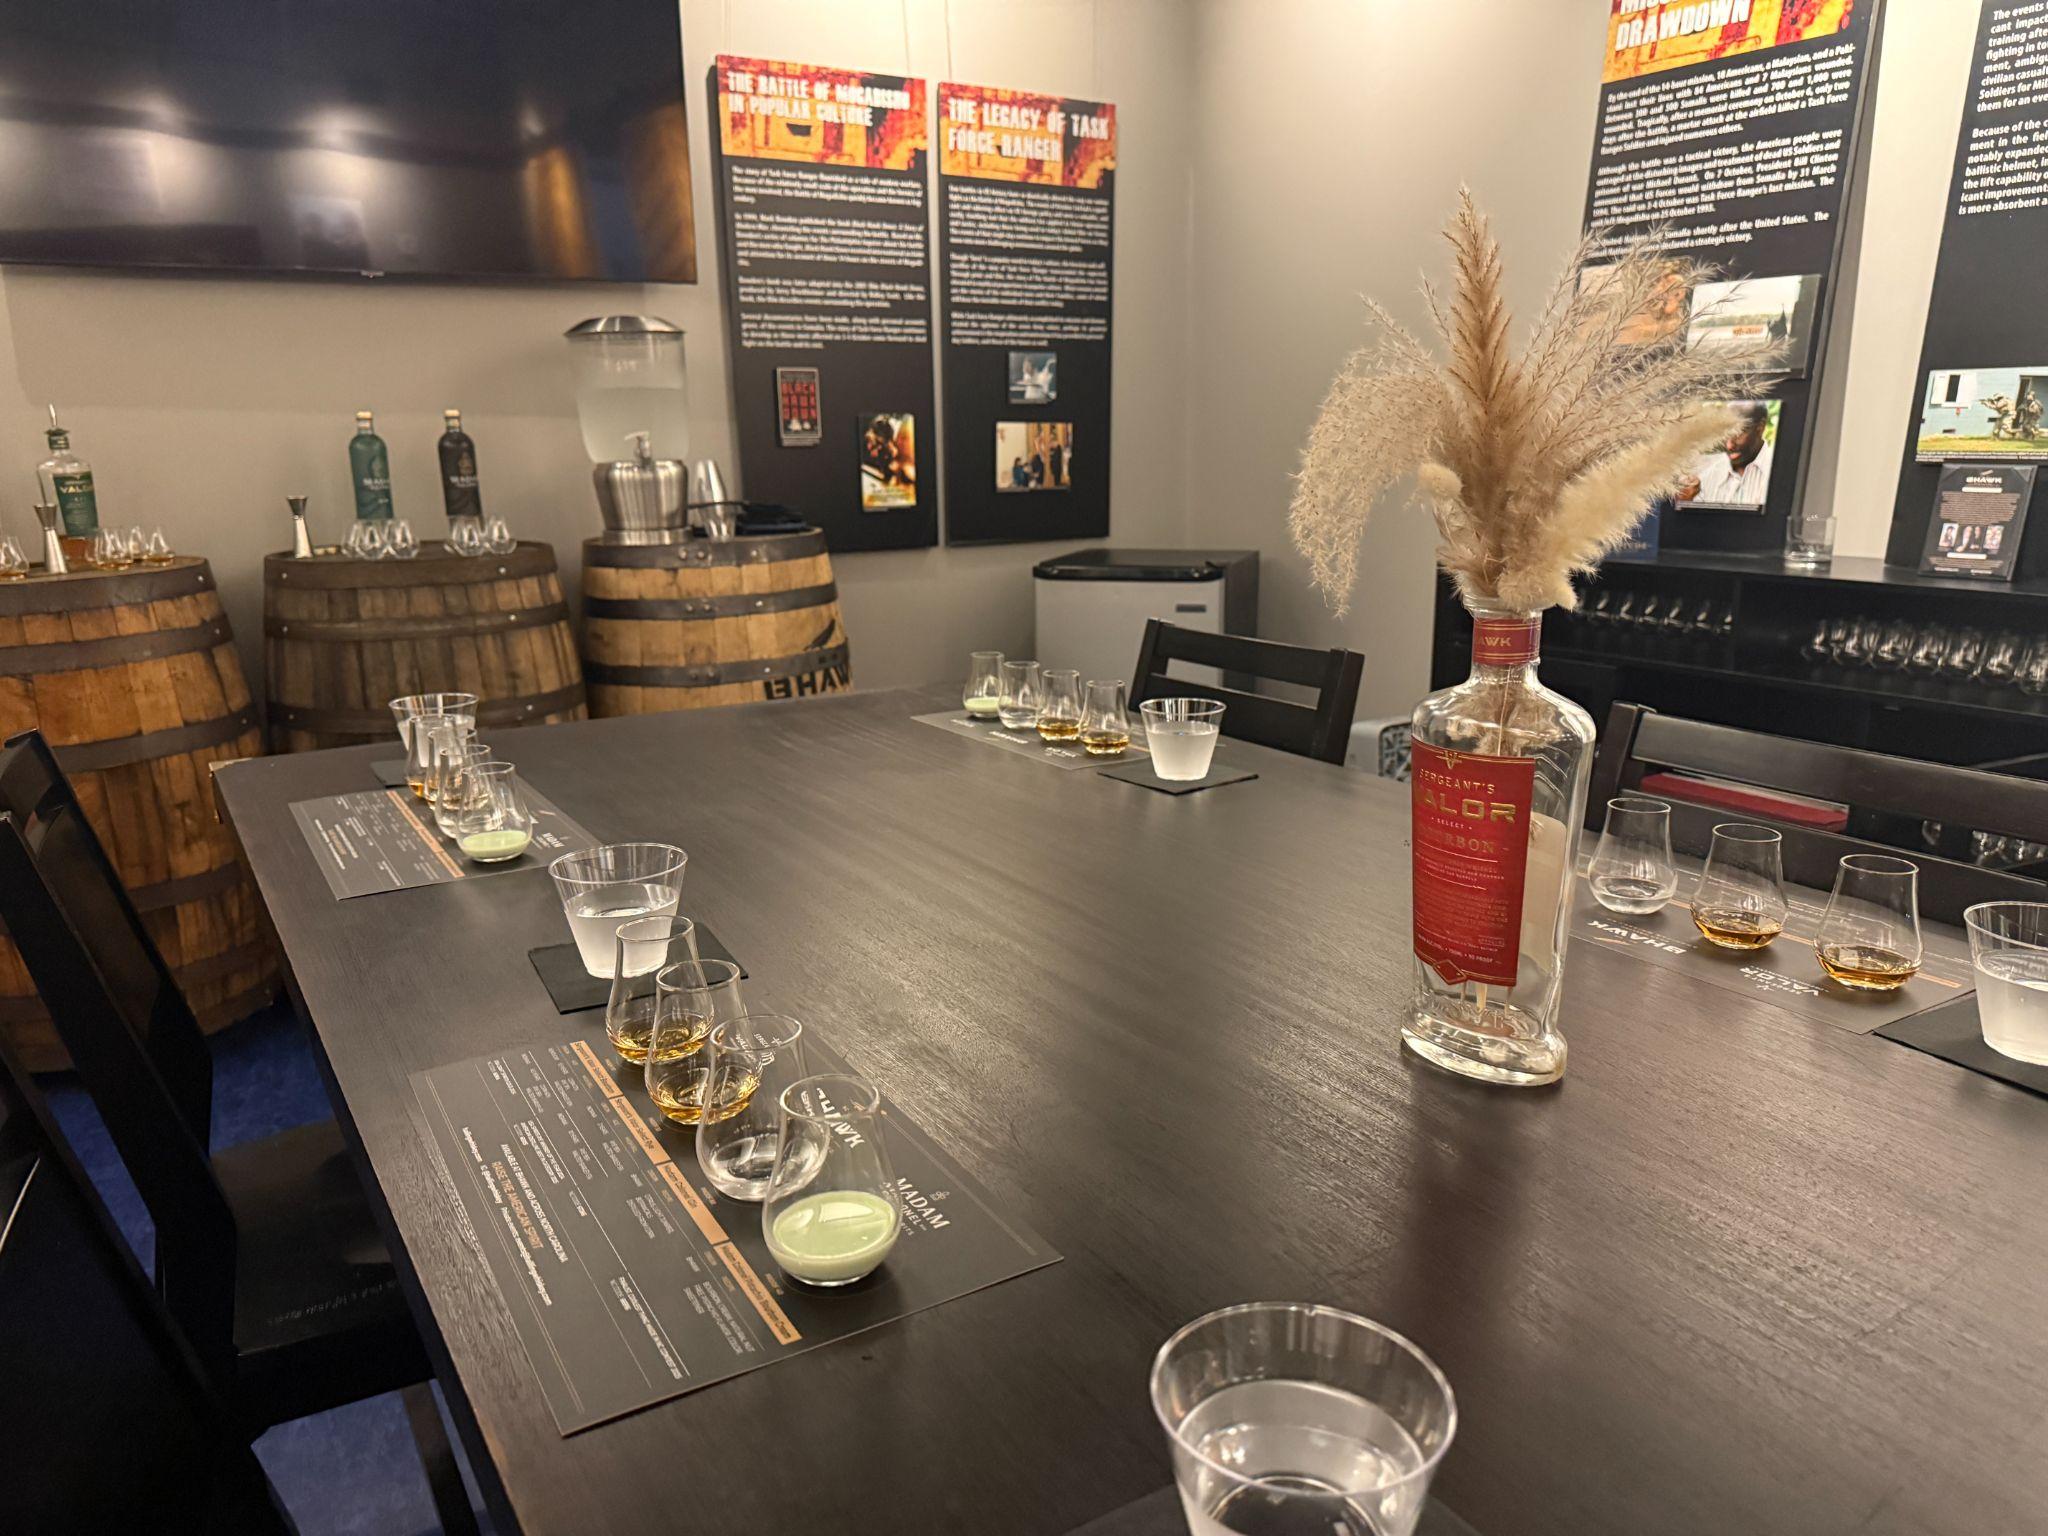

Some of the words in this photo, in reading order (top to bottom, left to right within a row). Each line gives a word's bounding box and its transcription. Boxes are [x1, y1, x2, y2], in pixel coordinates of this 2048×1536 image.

[1994, 10, 2010, 20] The
[2012, 3, 2044, 16] events
[1615, 0, 1751, 51] DRAWDOWN
[1990, 22, 2012, 34] cant
[1988, 33, 2026, 47] training
[1812, 49, 1828, 60] and
[1986, 46, 2024, 61] fighting
[2025, 42, 2036, 52] in
[1745, 75, 1760, 84] and
[1815, 57, 1854, 70] wounded.
[1984, 60, 2011, 73] ment,
[727, 71, 754, 93] THE
[758, 75, 809, 98] BATTLE
[814, 82, 830, 100] OF
[1730, 88, 1751, 99] killed
[1753, 84, 1768, 94] and
[1788, 77, 1804, 87] and
[1831, 70, 1852, 79] were
[1981, 73, 2014, 86] civilian
[1979, 86, 2016, 100] Soldiers
[2017, 82, 2032, 92] for
[728, 93, 746, 114] IN
[751, 97, 811, 120] POPULAR
[1778, 101, 1799, 112] killed
[1808, 96, 1825, 107] Task
[1826, 93, 1848, 102] Force
[1977, 101, 2002, 112] them
[2003, 97, 2018, 108] for
[2018, 96, 2030, 106] an
[948, 98, 976, 124] THE
[982, 103, 1043, 131] LEGACY
[1047, 111, 1066, 134] OF
[1070, 113, 1108, 141] TASK
[1972, 125, 2010, 138] Because
[2012, 120, 2023, 132] of
[2024, 120, 2041, 130] the
[948, 129, 997, 156] FORCE
[1000, 134, 1062, 163] RANGER
[1741, 143, 1754, 152] the
[1756, 138, 1791, 148] American
[1793, 133, 1820, 143] people
[1822, 130, 1842, 139] were
[1825, 140, 1840, 150] and
[1970, 139, 1995, 151] ment
[1998, 136, 2008, 146] in
[2012, 134, 2028, 145] the
[1757, 160, 1792, 170] President
[1794, 157, 1808, 166] Bill
[1810, 153, 1839, 162] Clinton
[1968, 150, 2003, 164] notably
[1736, 176, 1754, 185] from
[1756, 172, 1786, 181] Somalia
[1787, 169, 1798, 179] by
[1812, 164, 1837, 173] March
[1965, 164, 2002, 177] ballistic
[2002, 158, 2038, 172] helmet,
[1717, 189, 1735, 199] Force
[1737, 186, 1767, 196] Ranger's
[1769, 183, 1783, 192] last
[1785, 179, 1816, 188] mission.
[1820, 175, 1835, 185] The
[1964, 179, 1979, 190] the
[1980, 176, 1995, 188] lift
[1996, 172, 2042, 186] capability
[1959, 205, 1966, 215] is
[1968, 204, 1992, 214] more
[1993, 197, 2041, 211] absorbent
[1961, 191, 1984, 202] icant
[1665, 229, 1692, 237] Somalia
[1693, 226, 1718, 234] shortly
[1720, 222, 1738, 231] after
[1740, 220, 1753, 229] the
[1755, 218, 1781, 226] United
[1782, 215, 1809, 223] States.
[1815, 211, 1829, 220] The
[1419, 768, 1495, 794] SERGEANT'S
[1421, 787, 1516, 824] ALOR
[1587, 920, 1687, 954] BHAWK
[500, 1142, 518, 1166] AVAILABLE
[491, 1160, 508, 1180] RAISE
[514, 1170, 530, 1190] BHAWK
[499, 1178, 514, 1193] THE
[523, 1188, 535, 1200] AND
[506, 1191, 531, 1227] AMERICAN
[528, 1198, 545, 1219] ACROSS
[896, 1177, 950, 1229] MADAM
[538, 1216, 555, 1236] NORTH
[523, 1225, 542, 1250] SPIRIT
[547, 1234, 568, 1263] CAROLINA
